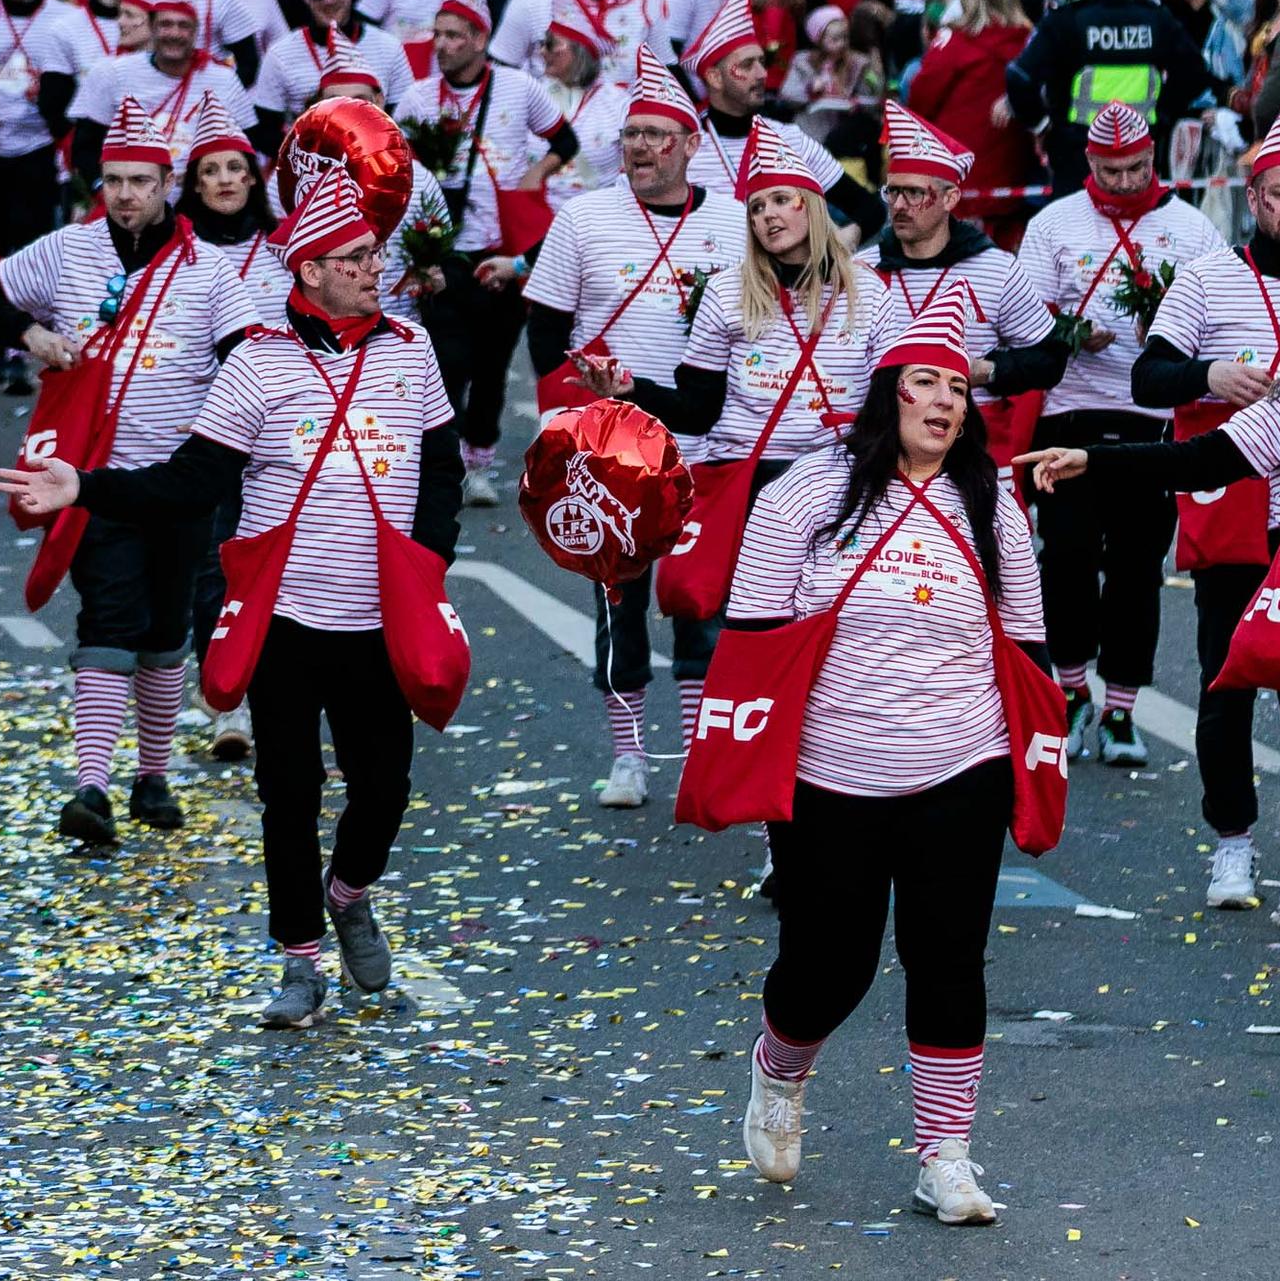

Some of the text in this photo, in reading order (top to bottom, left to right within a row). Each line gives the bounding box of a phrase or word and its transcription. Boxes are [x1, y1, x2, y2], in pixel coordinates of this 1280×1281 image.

[1086, 25, 1153, 51] POLIZEI
[557, 520, 591, 536] 1.FC
[563, 535, 588, 546] KÖLN
[921, 569, 959, 584] BLÖHE
[696, 697, 775, 742] FC
